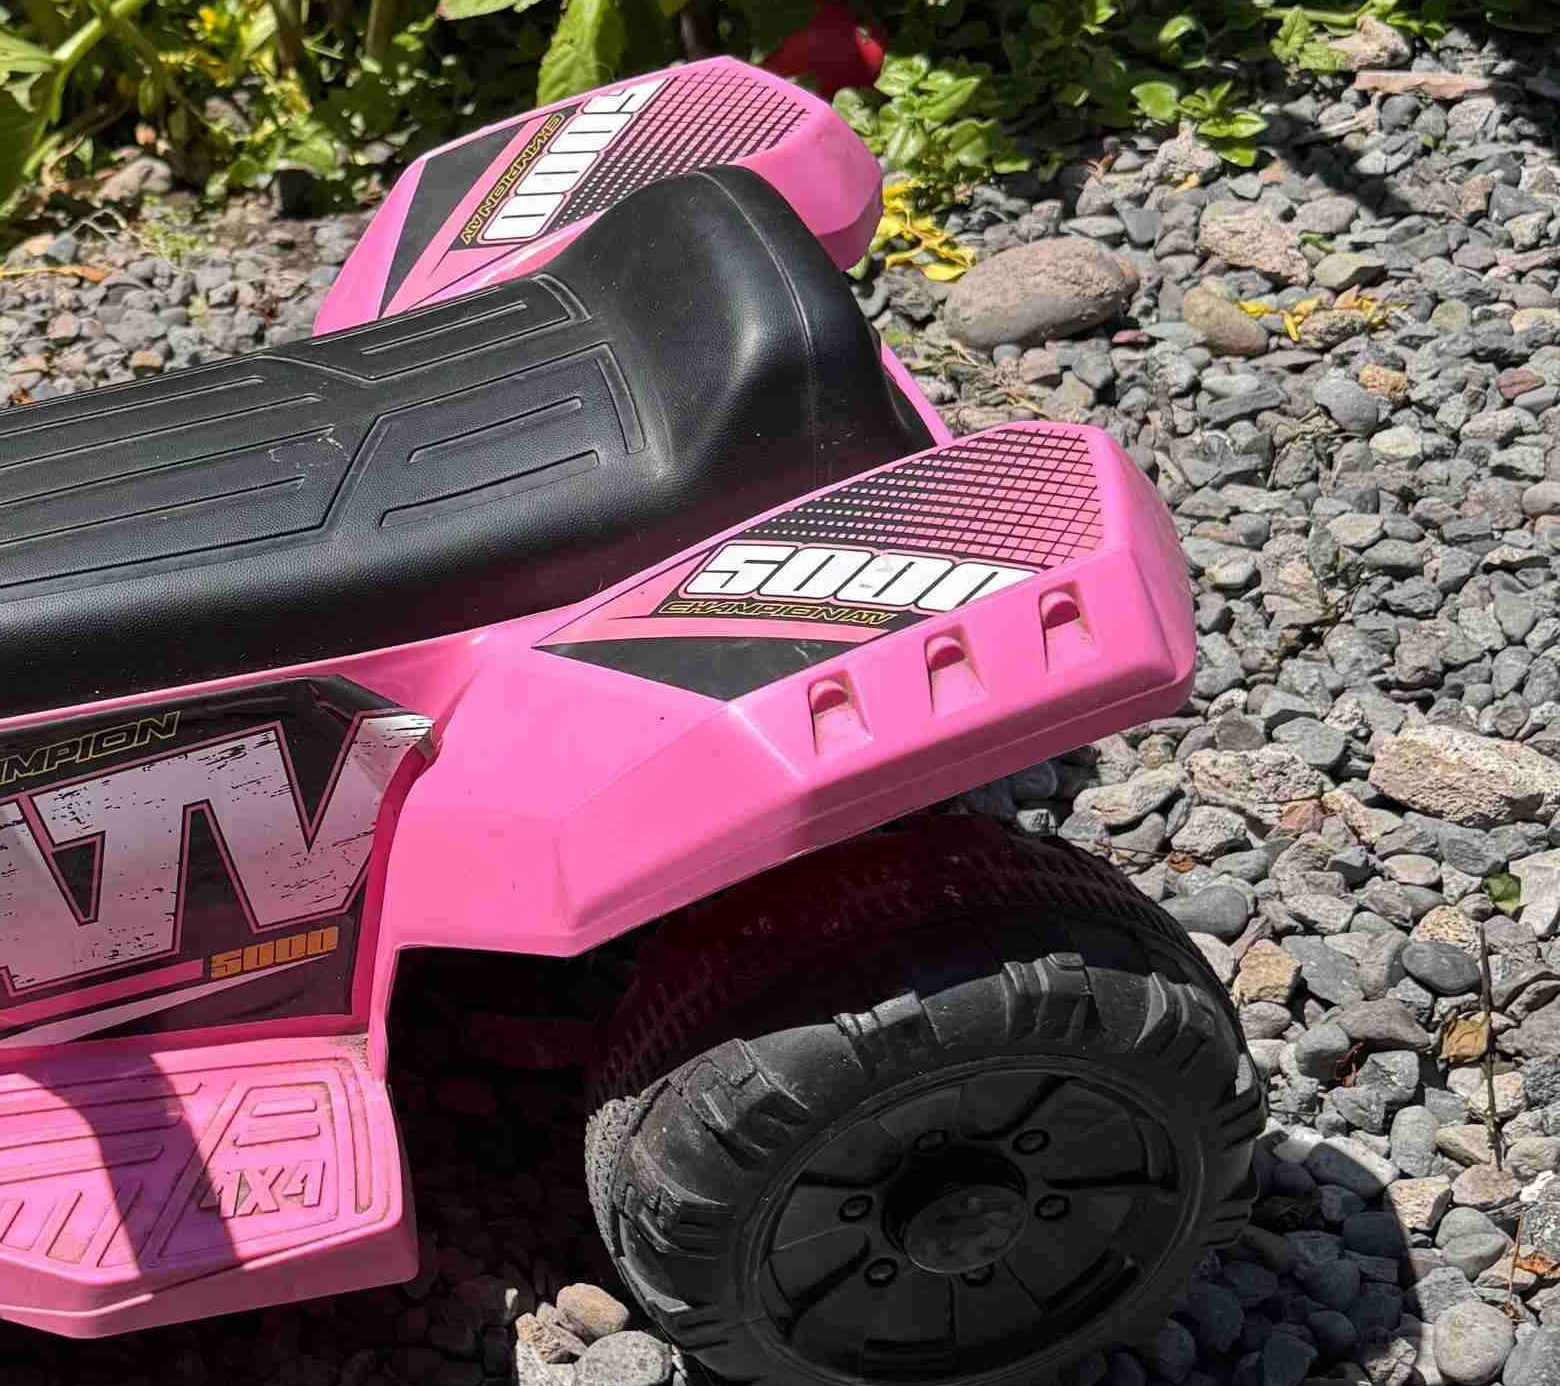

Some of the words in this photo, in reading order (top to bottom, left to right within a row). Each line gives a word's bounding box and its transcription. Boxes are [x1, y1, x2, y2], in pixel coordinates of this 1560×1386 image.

[480, 113, 566, 220] CHAMPION
[684, 543, 1042, 612] 5000
[659, 600, 841, 622] CHAMPION
[209, 925, 340, 981] 5000
